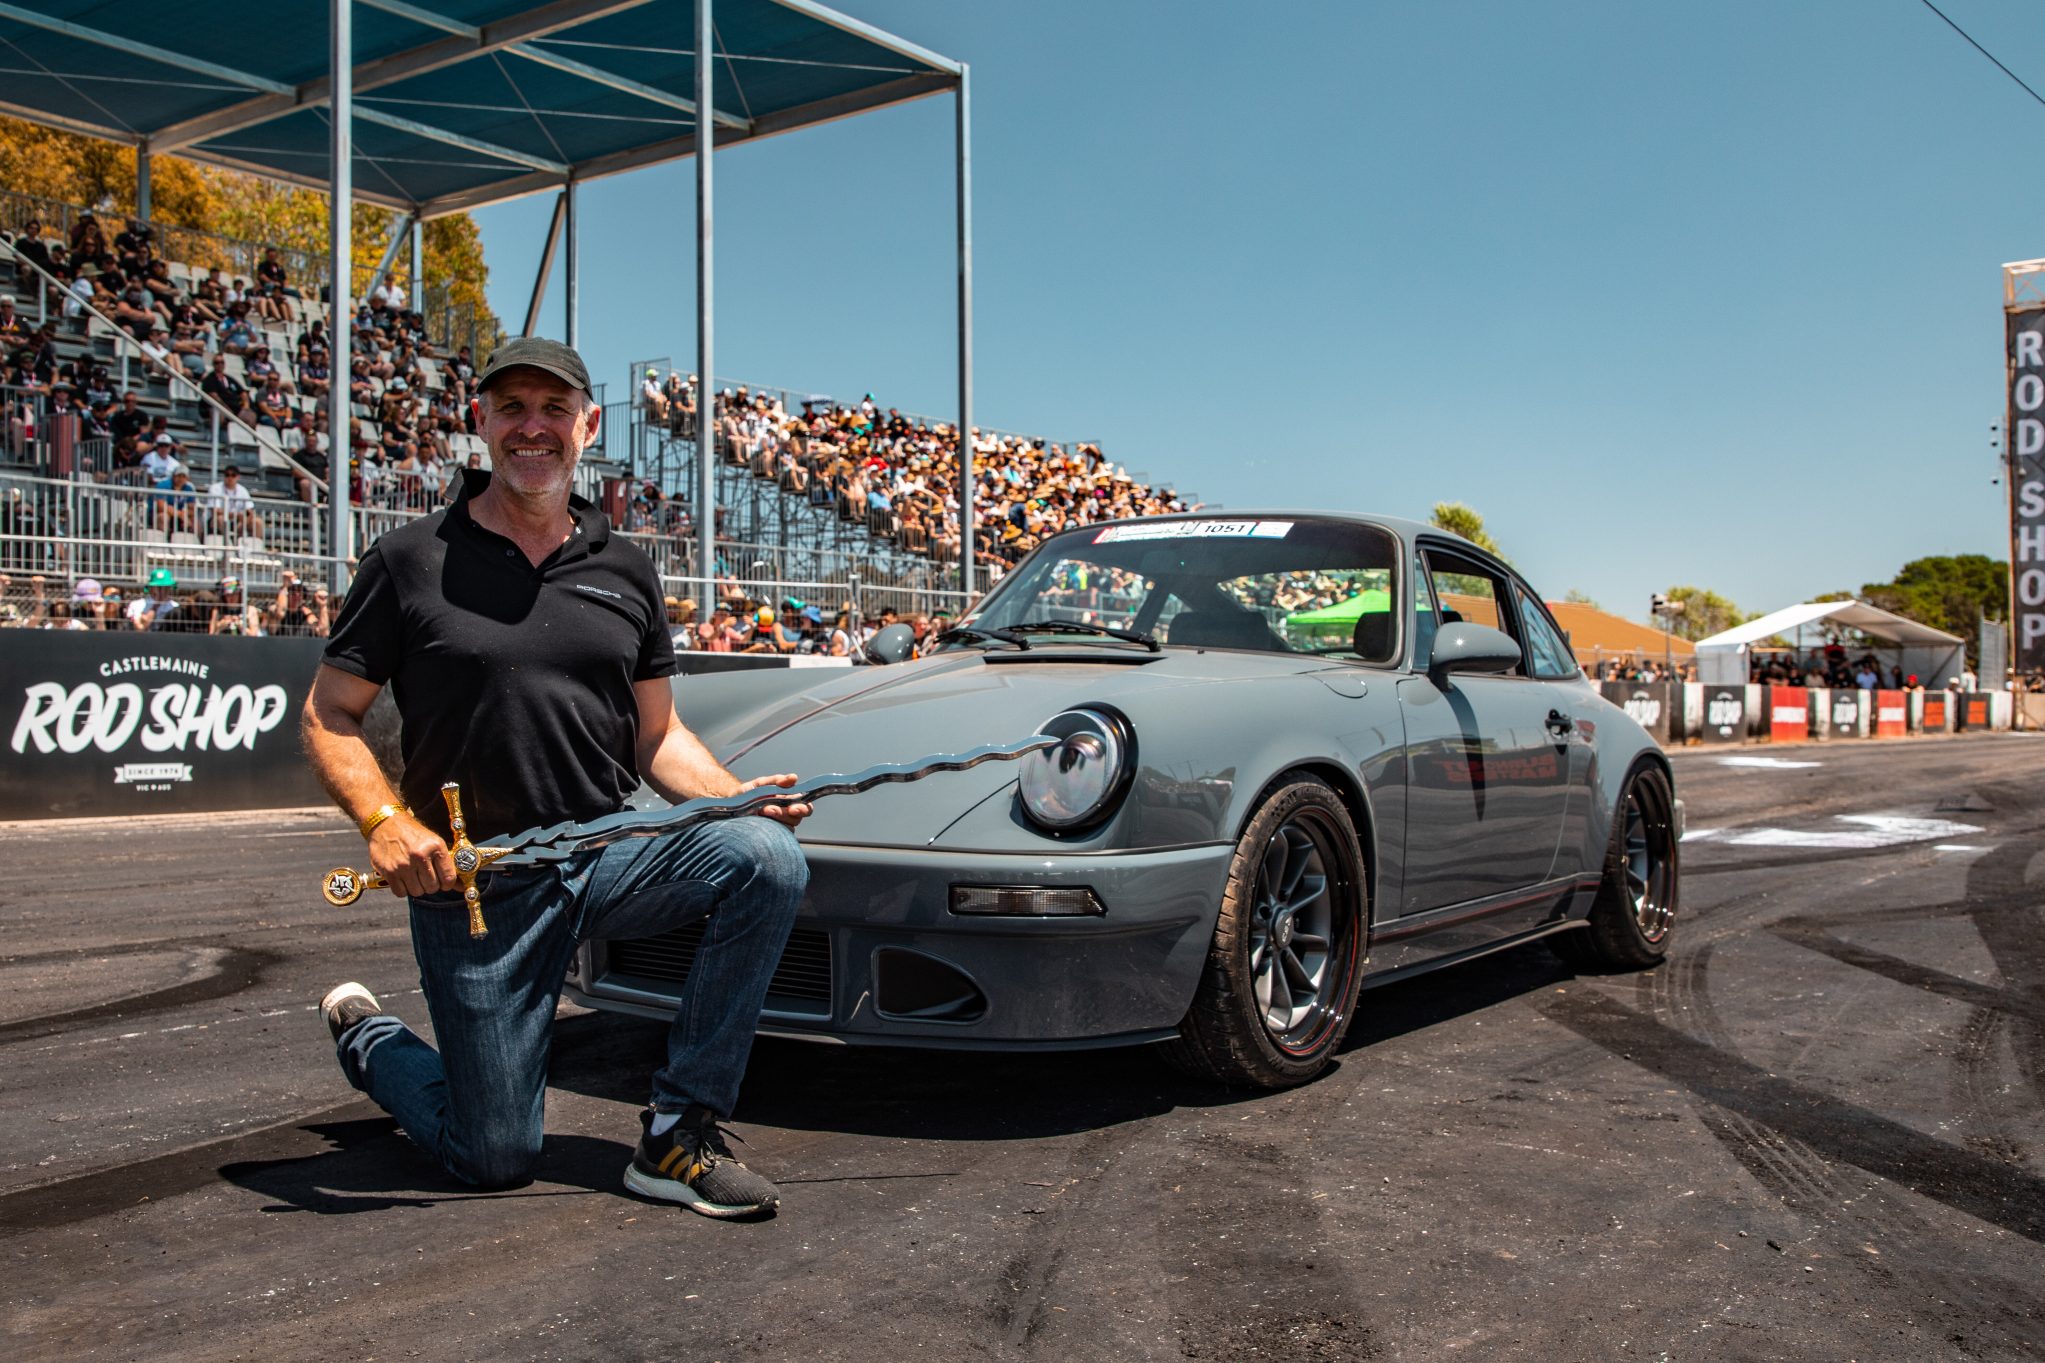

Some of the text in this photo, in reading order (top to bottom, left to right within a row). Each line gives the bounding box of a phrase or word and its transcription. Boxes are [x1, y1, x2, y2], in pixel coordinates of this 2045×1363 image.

[2016, 330, 2045, 650] ROD SHOP
[1204, 524, 1246, 533] 1051
[576, 584, 622, 599] PORSCHE
[100, 656, 209, 679] CASTLEMAINE
[11, 682, 288, 754] ROD SHOP
